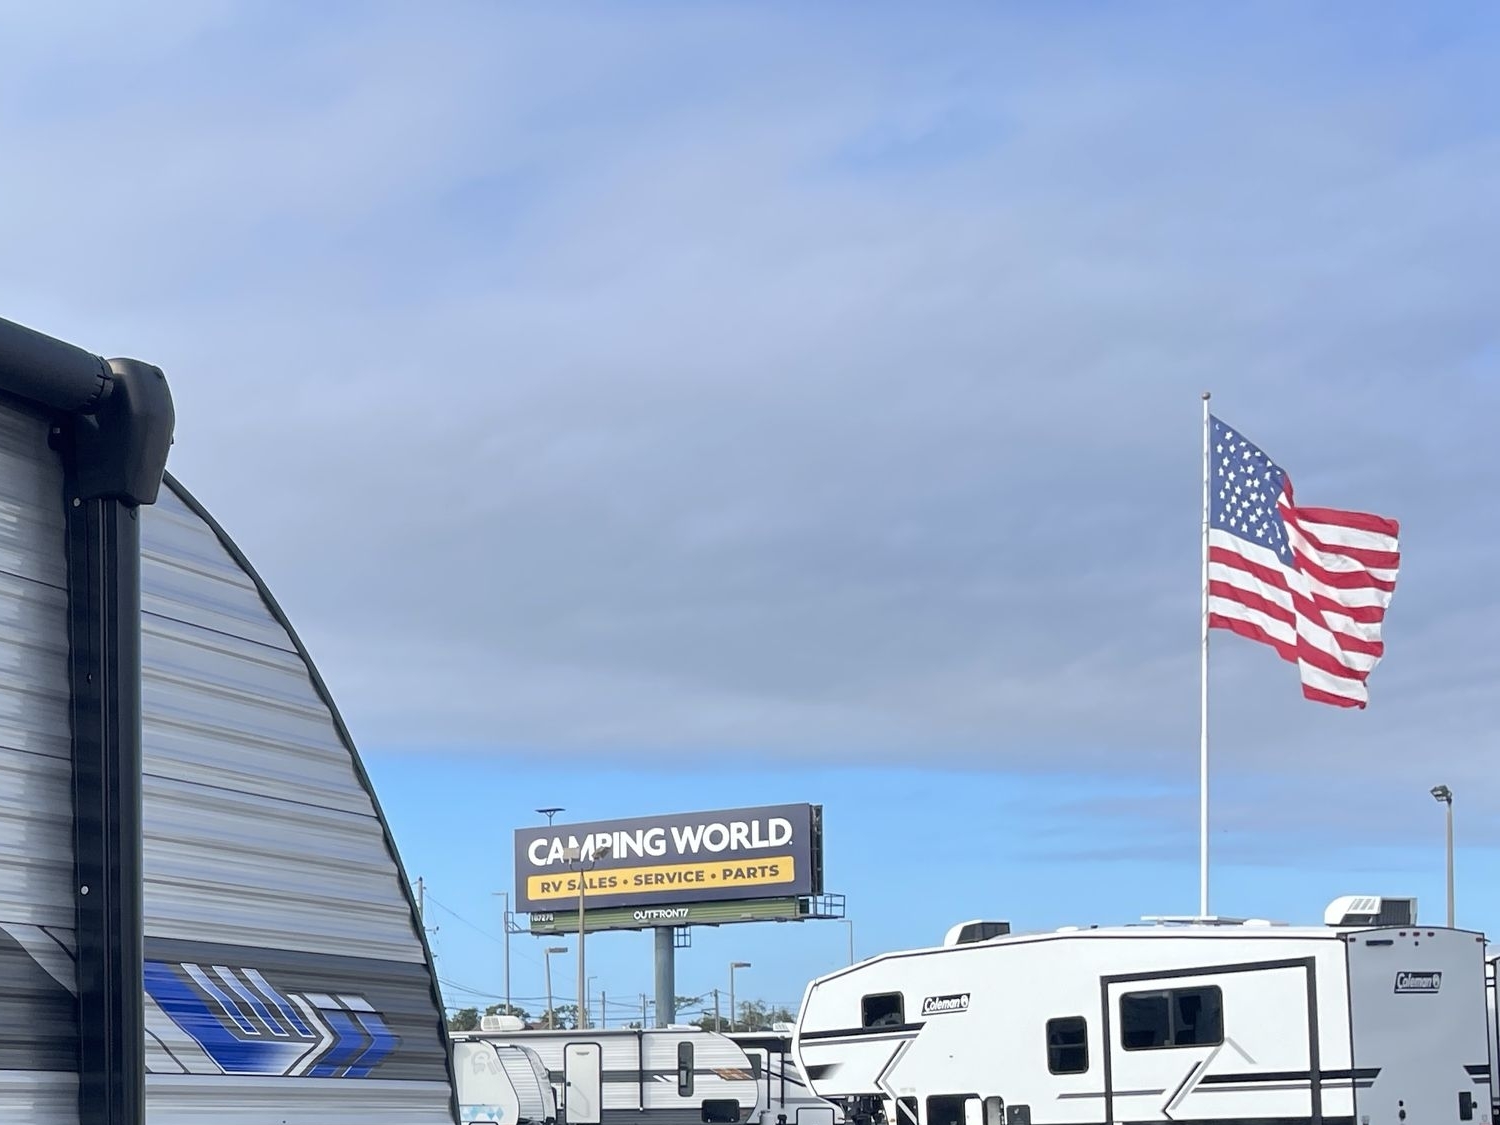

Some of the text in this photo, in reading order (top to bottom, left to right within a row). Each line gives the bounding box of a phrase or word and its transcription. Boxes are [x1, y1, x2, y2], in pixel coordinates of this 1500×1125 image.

[527, 827, 667, 867] CAMPING
[540, 864, 780, 894] RV SALES SERVICE PARTS
[1396, 972, 1433, 989] Coleman
[924, 996, 961, 1012] Coleman
